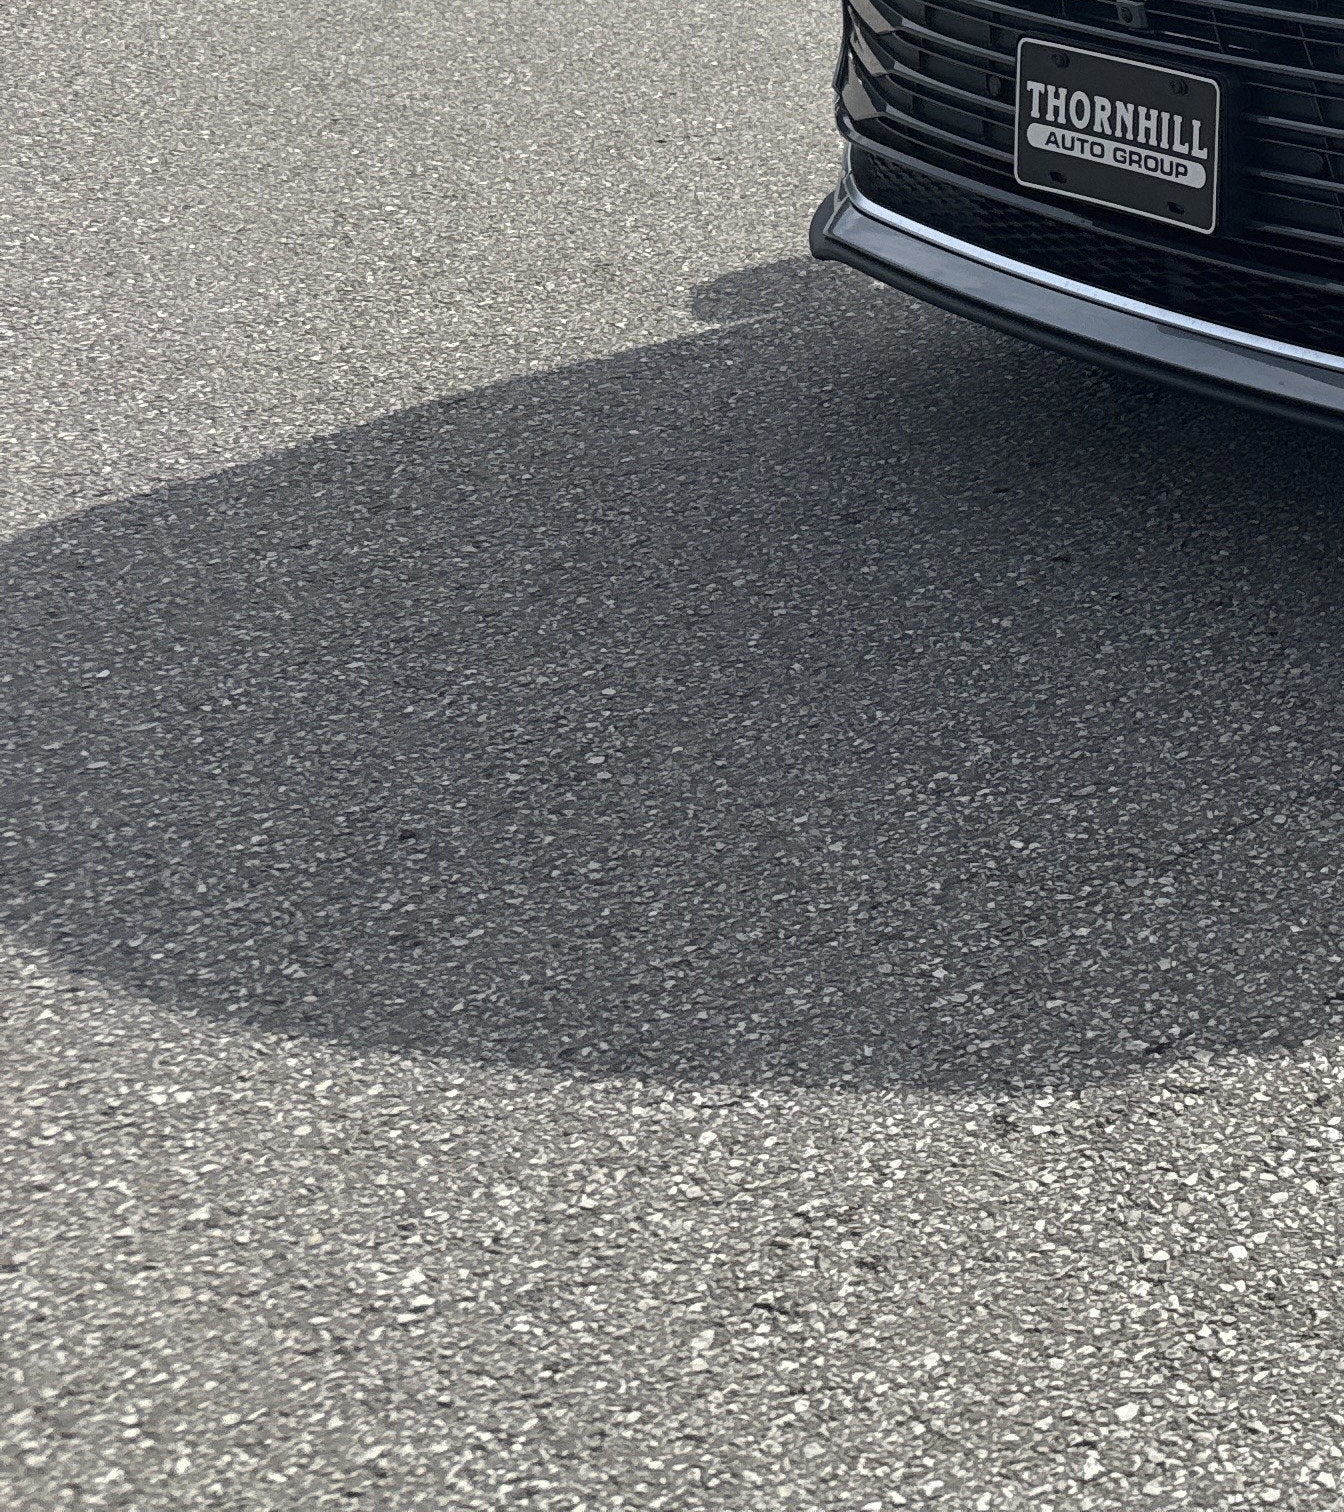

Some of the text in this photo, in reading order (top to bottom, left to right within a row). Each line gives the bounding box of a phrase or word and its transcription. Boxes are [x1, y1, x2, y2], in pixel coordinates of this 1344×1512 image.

[1026, 80, 1208, 160] THORNHILL
[1045, 131, 1189, 179] AUTO GROUP
